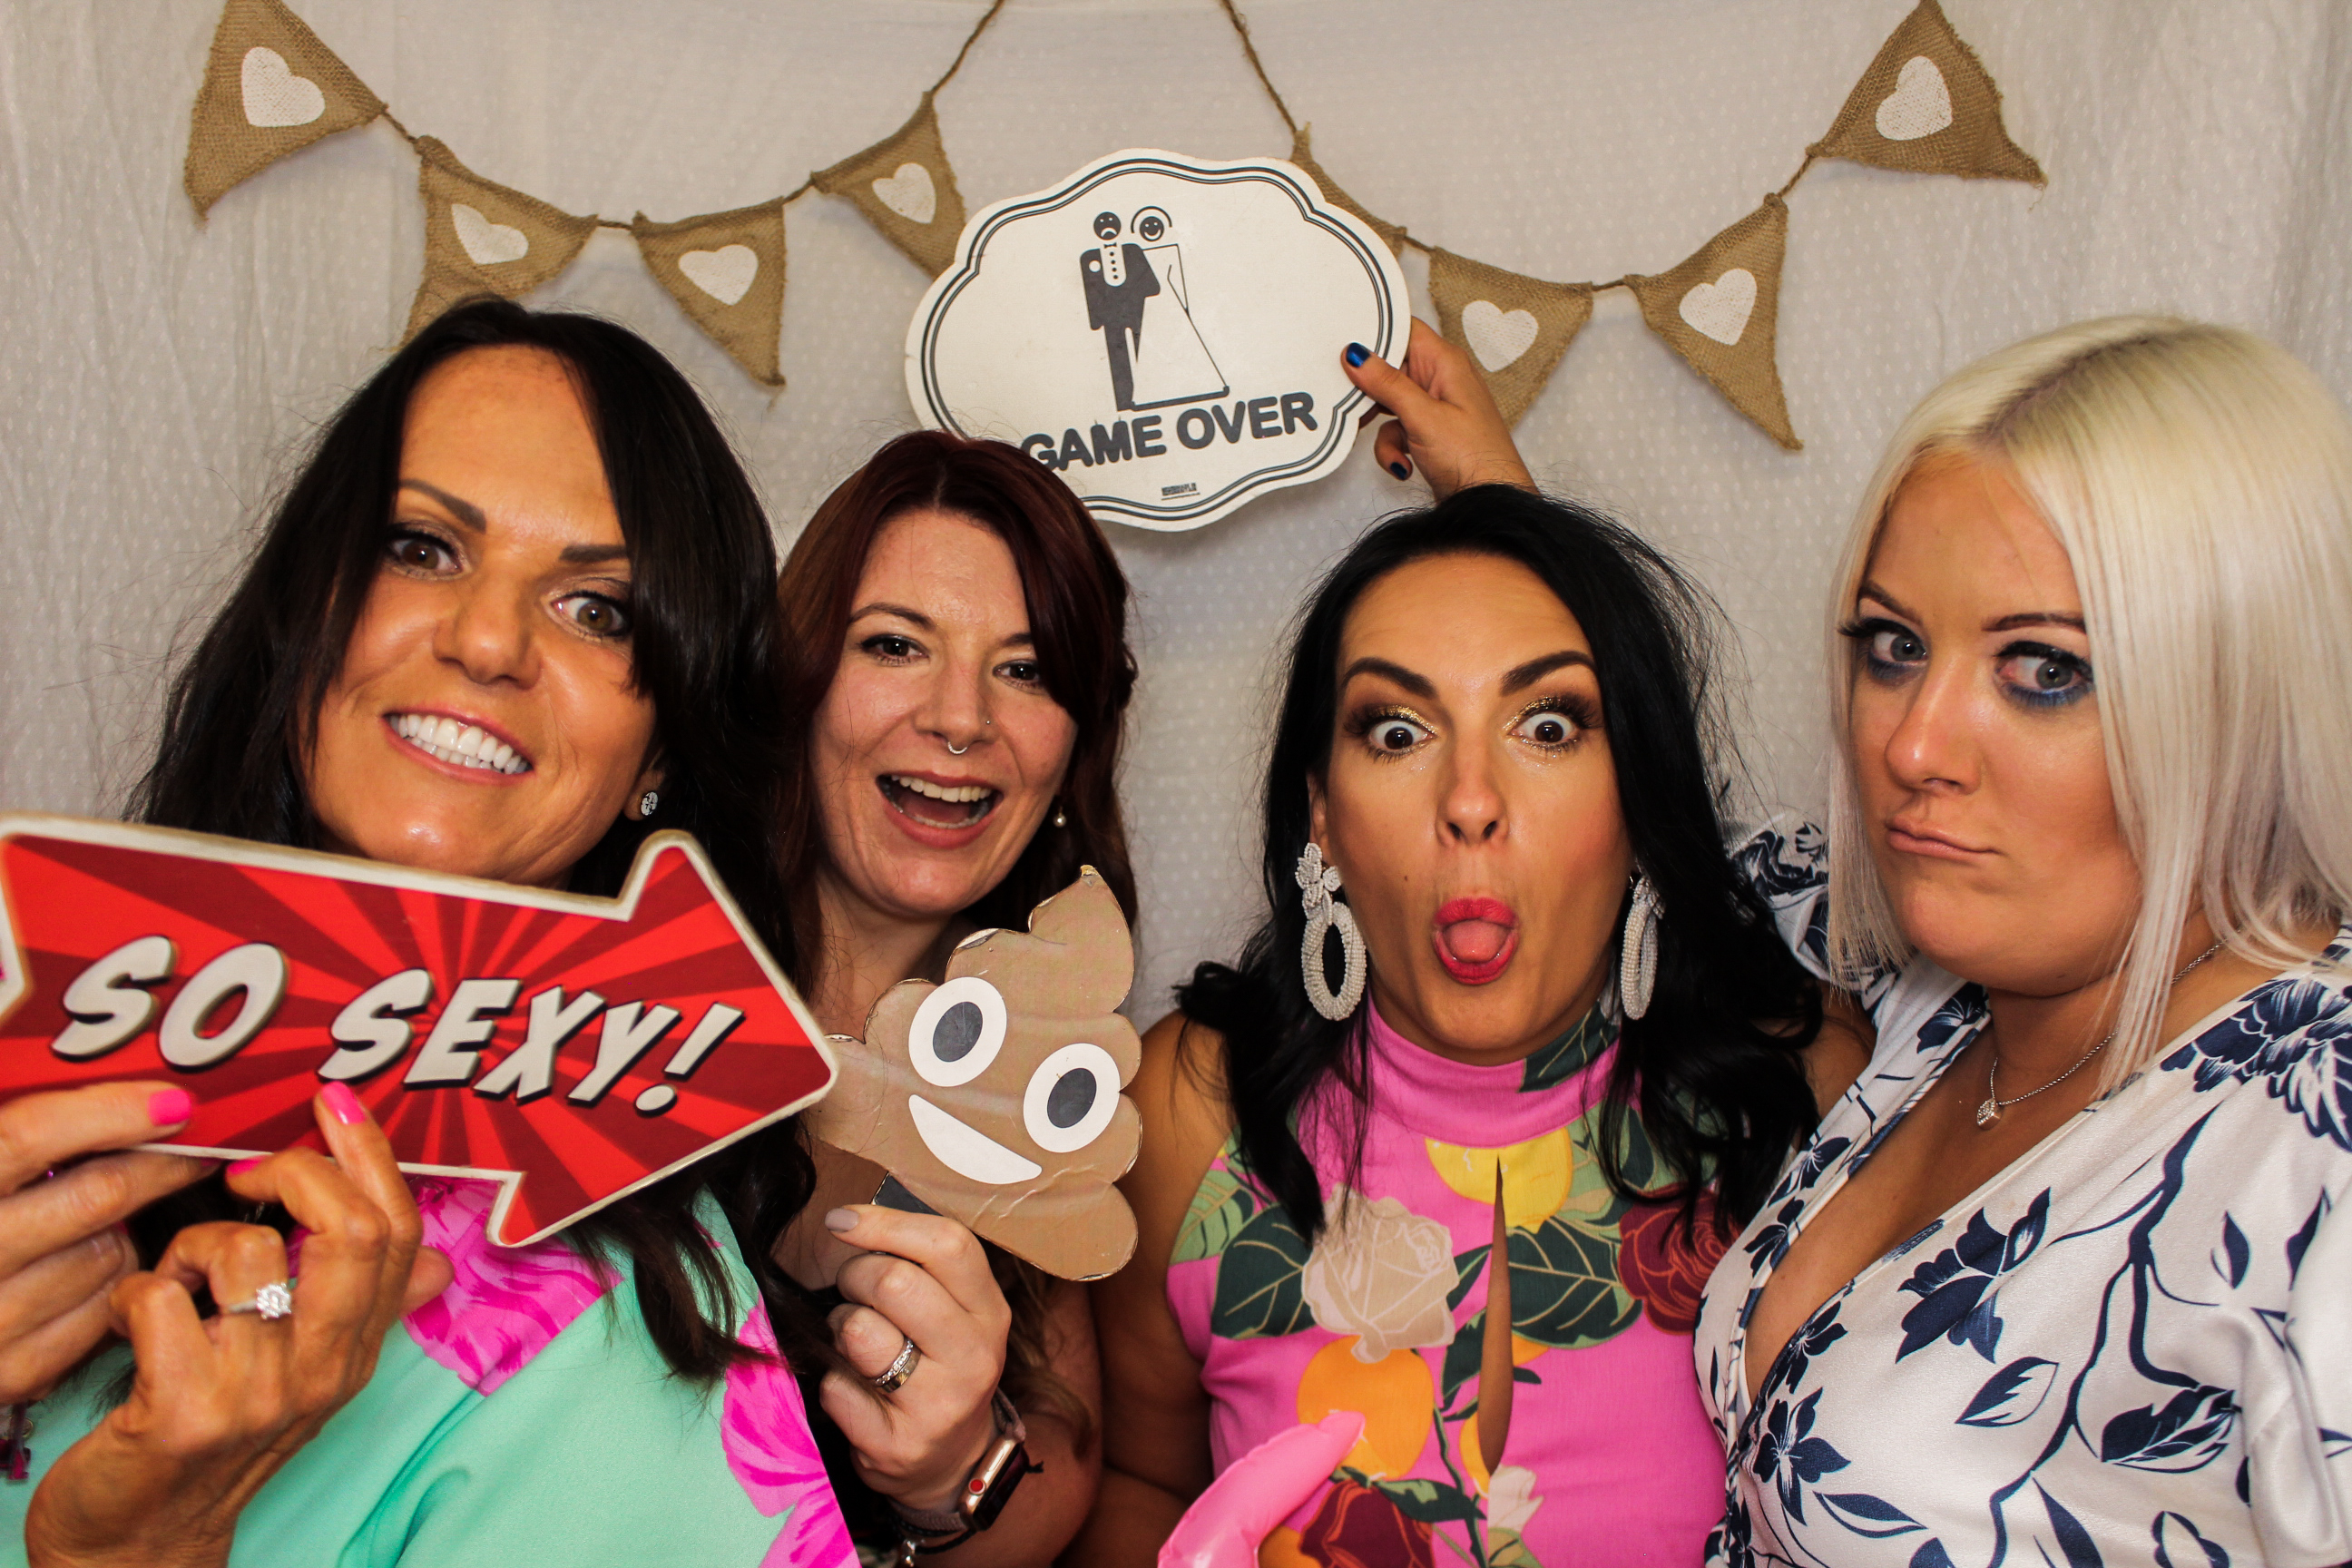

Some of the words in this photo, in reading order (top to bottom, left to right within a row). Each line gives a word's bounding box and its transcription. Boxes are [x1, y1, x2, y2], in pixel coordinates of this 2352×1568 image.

[1021, 415, 1167, 472] GAME
[1177, 392, 1318, 449] OVER
[51, 935, 289, 1071] SO
[318, 968, 746, 1116] SEXY!
